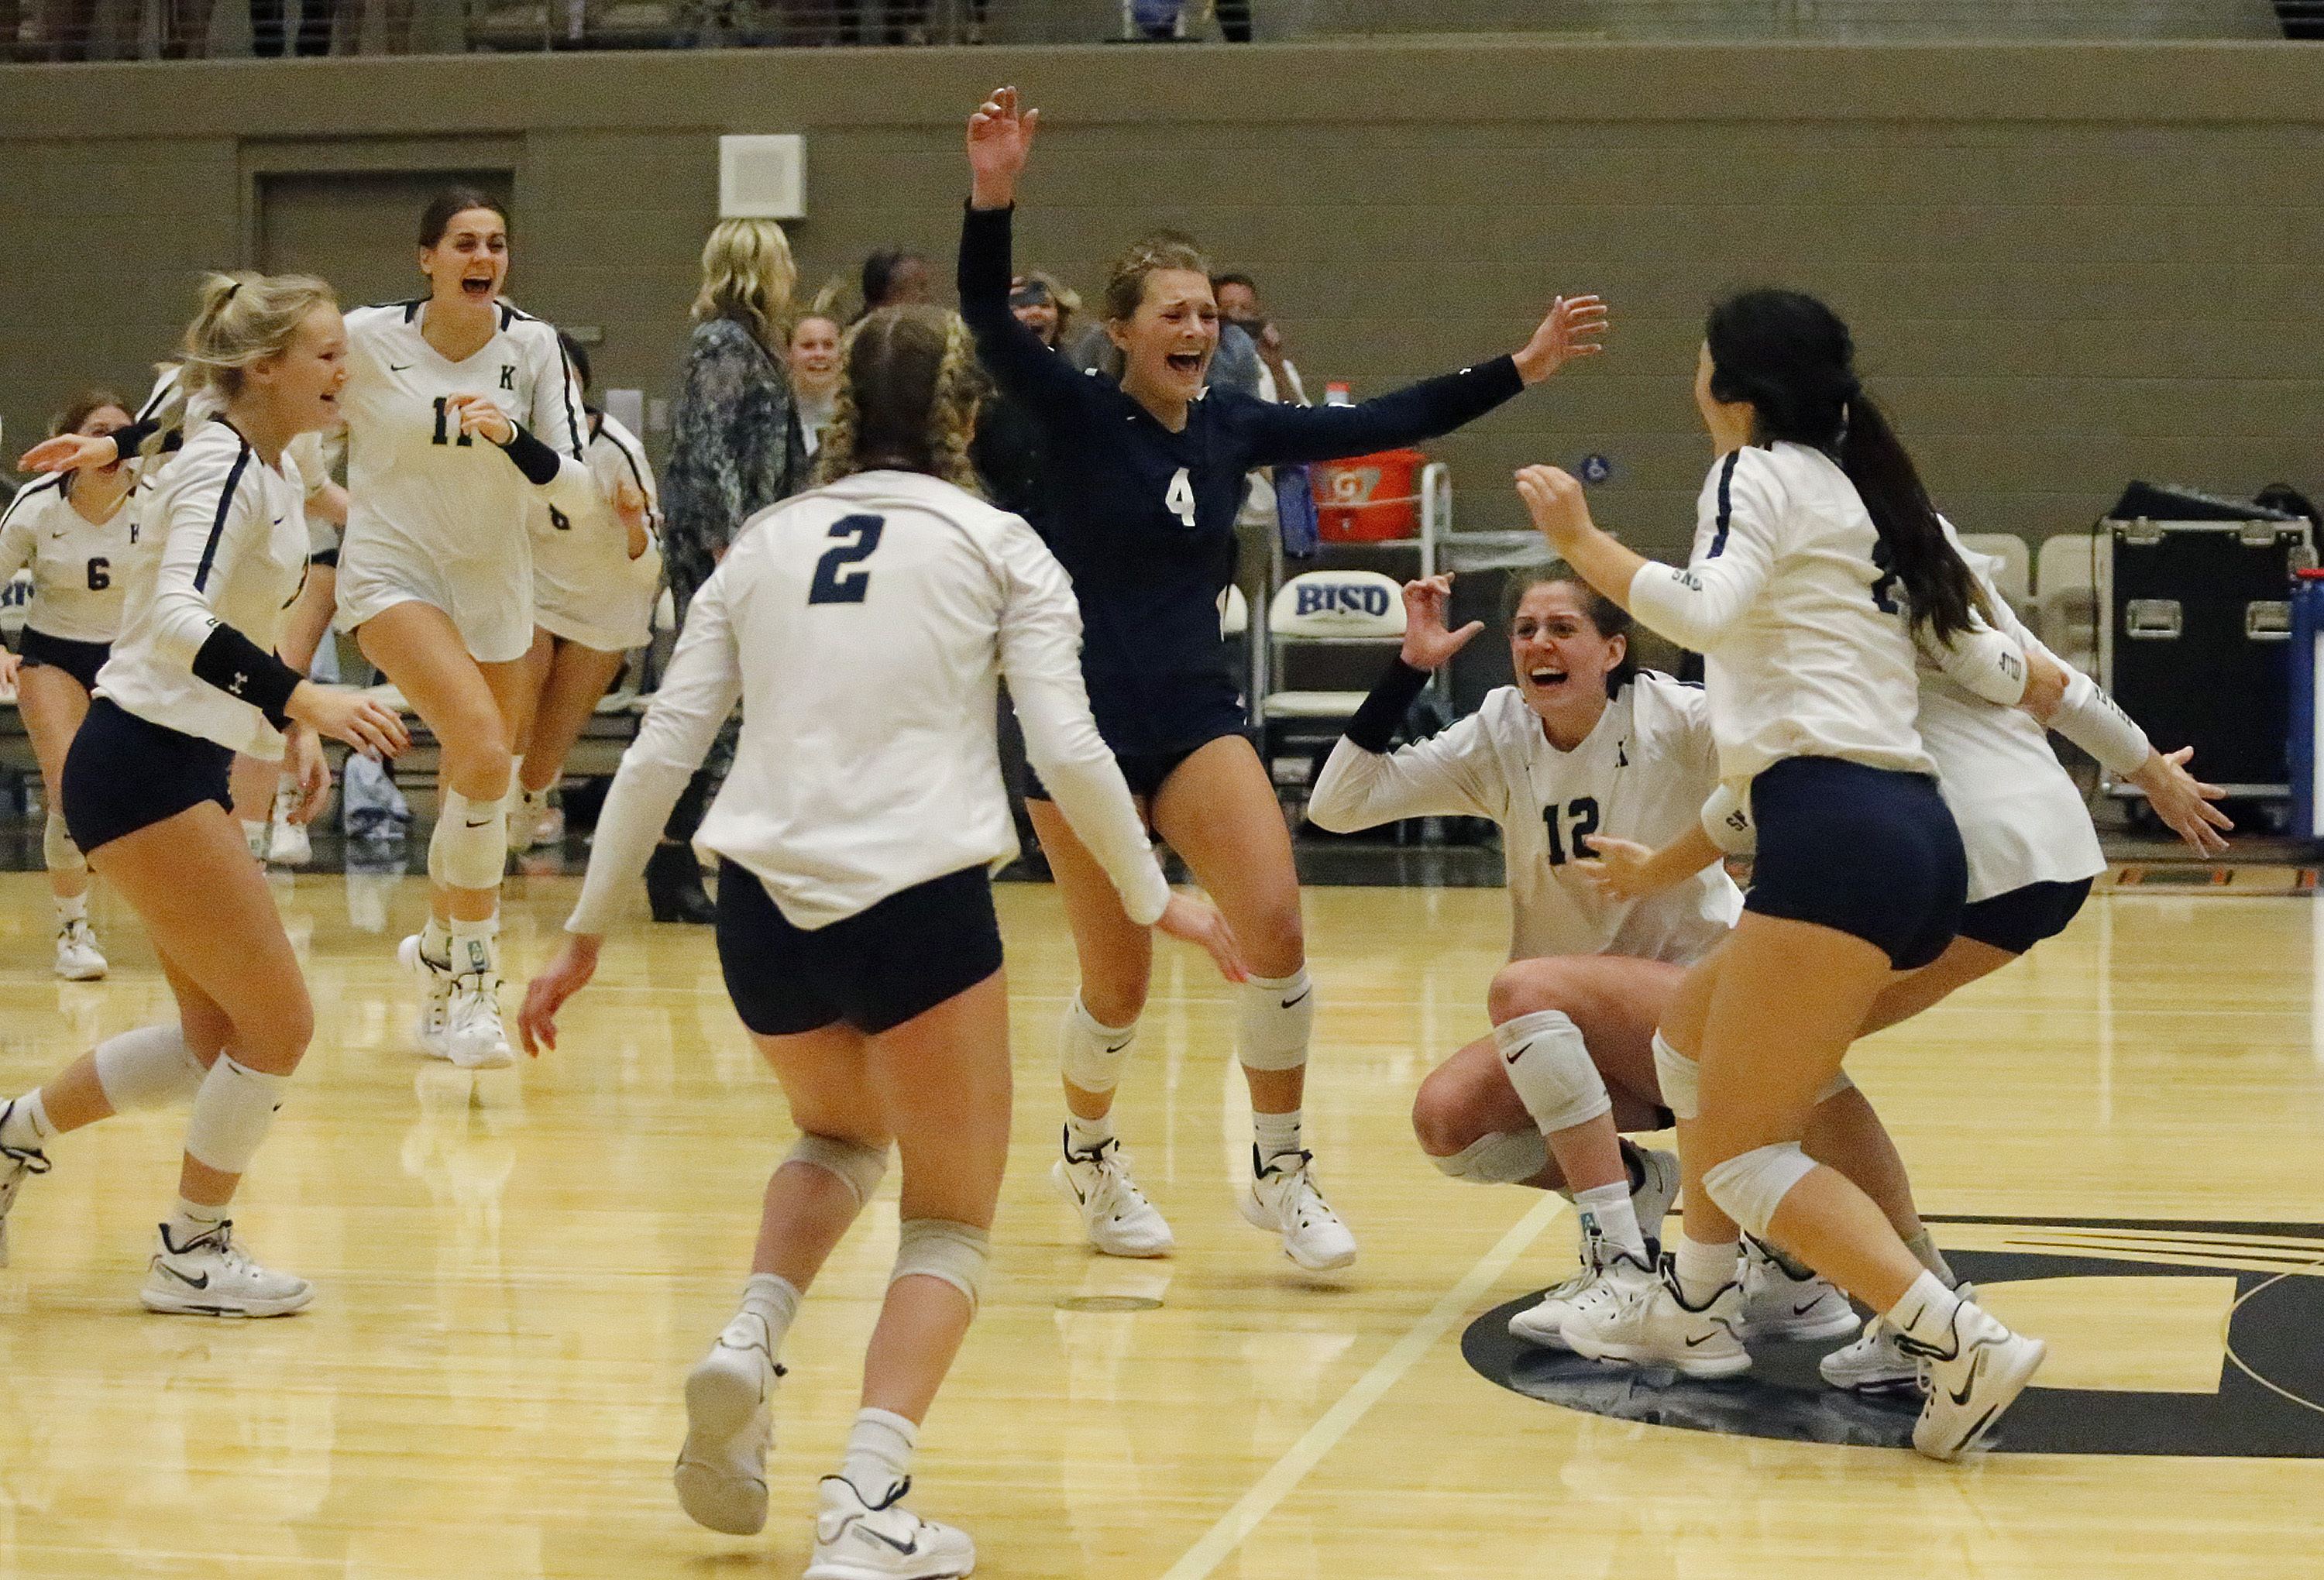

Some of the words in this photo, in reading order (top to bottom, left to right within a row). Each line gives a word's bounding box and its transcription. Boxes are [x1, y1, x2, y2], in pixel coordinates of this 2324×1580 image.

[500, 364, 516, 390] K
[433, 397, 472, 446] 1
[1165, 467, 1196, 527] 4
[88, 557, 111, 591] 6
[808, 514, 885, 604] 2
[1296, 584, 1389, 617] BISD
[1542, 795, 1601, 866] 12
